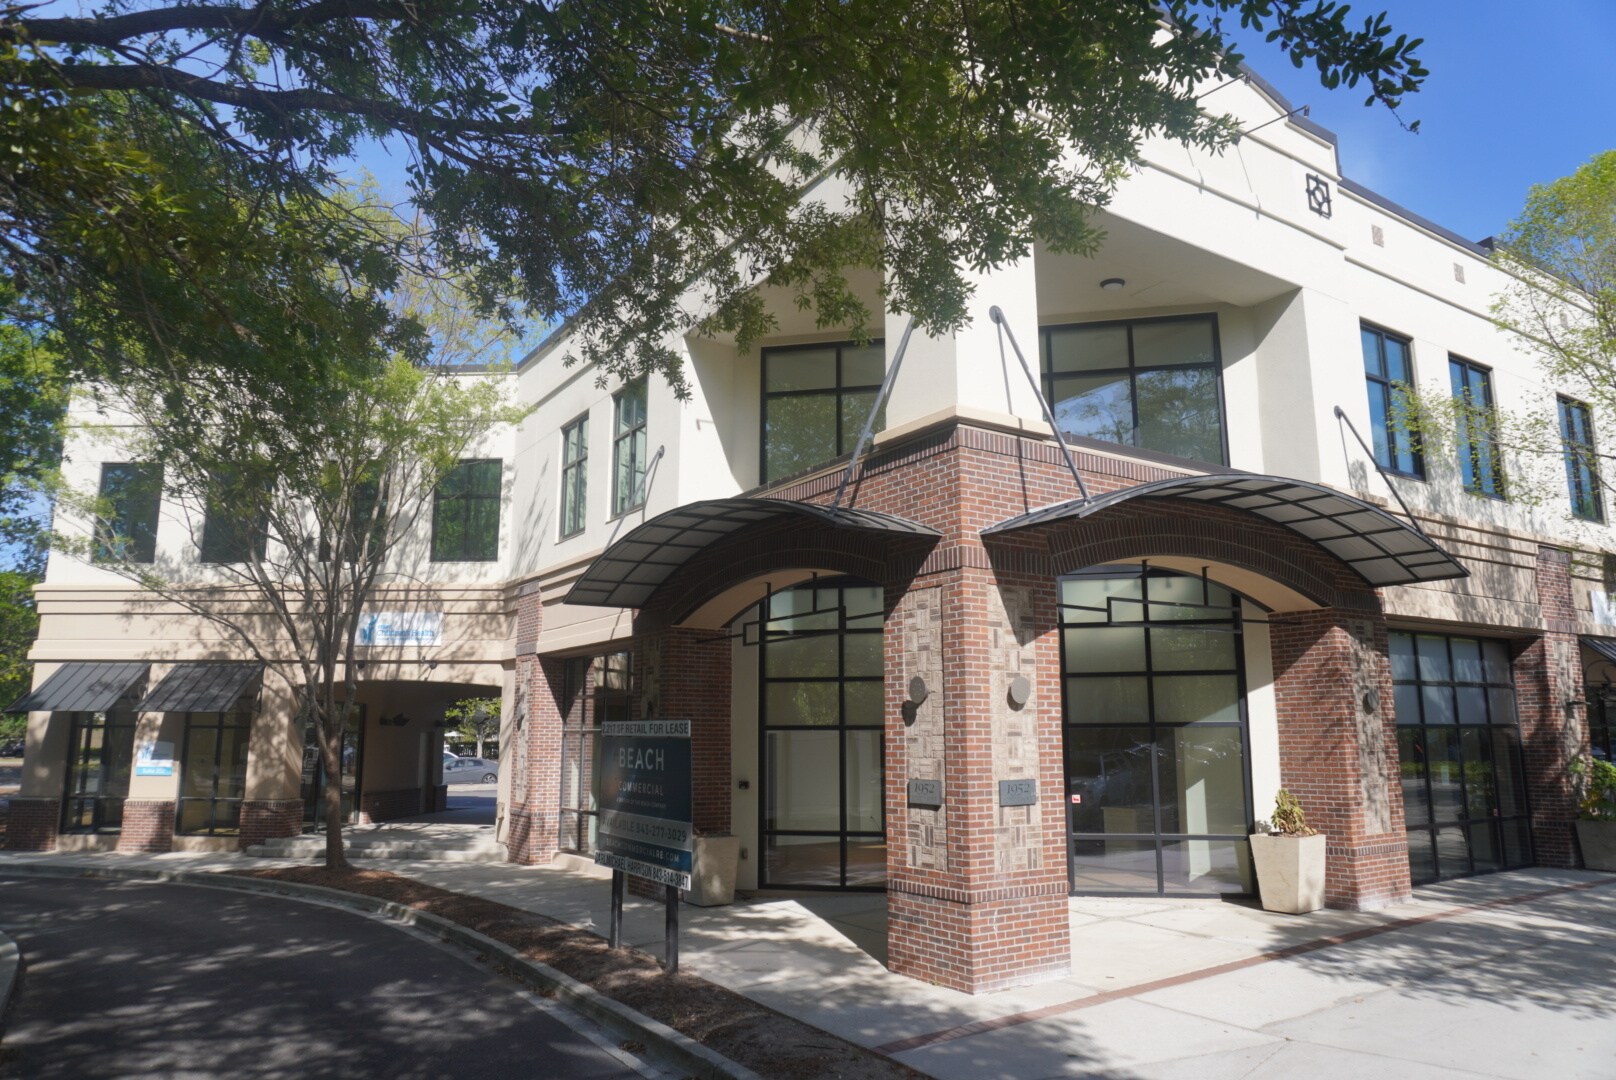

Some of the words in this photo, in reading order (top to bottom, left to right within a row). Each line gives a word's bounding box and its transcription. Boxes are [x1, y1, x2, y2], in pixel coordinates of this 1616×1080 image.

[625, 723, 647, 734] RETAIL
[649, 723, 664, 734] FOR
[665, 722, 689, 734] LEASE
[619, 747, 665, 771] BEACH
[618, 781, 664, 796] COMMERCIAL
[914, 783, 935, 796] 1952
[1007, 783, 1030, 796] 1952
[637, 822, 688, 843] 843-277-3029
